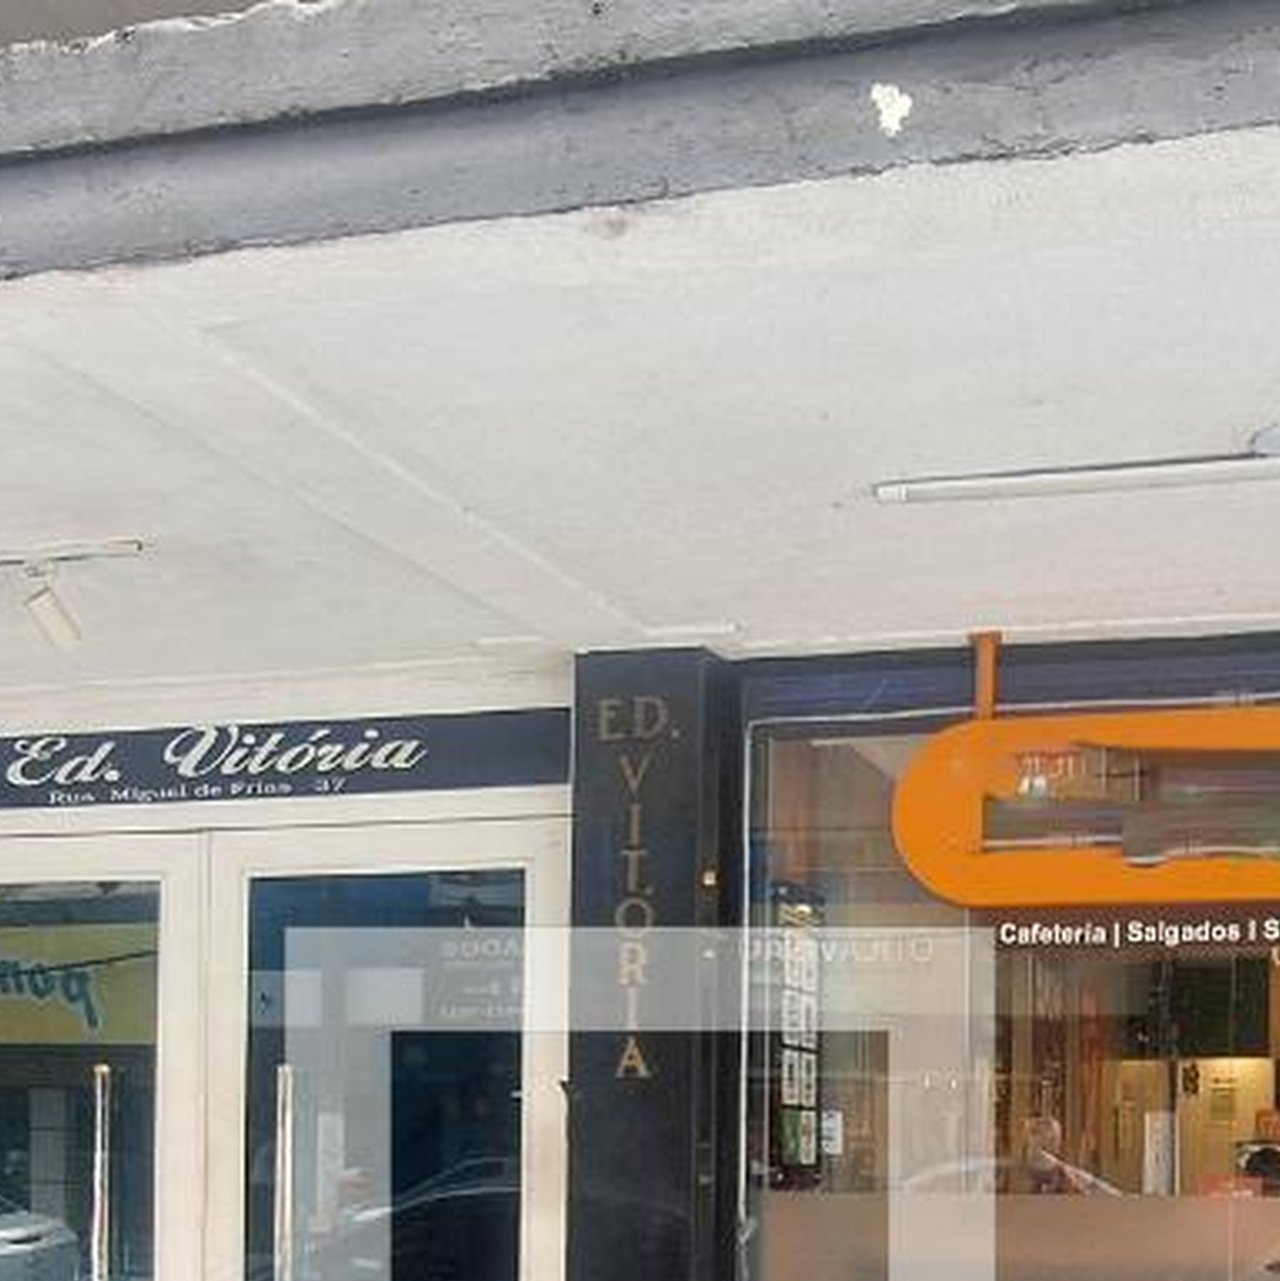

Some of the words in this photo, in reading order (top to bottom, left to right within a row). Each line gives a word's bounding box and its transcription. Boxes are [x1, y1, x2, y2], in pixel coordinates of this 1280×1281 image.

[6, 736, 121, 786] Ed.
[163, 724, 427, 779] Vitória
[194, 782, 223, 798] de
[1000, 922, 1107, 945] Cafeteria
[1126, 920, 1240, 947] Salgados
